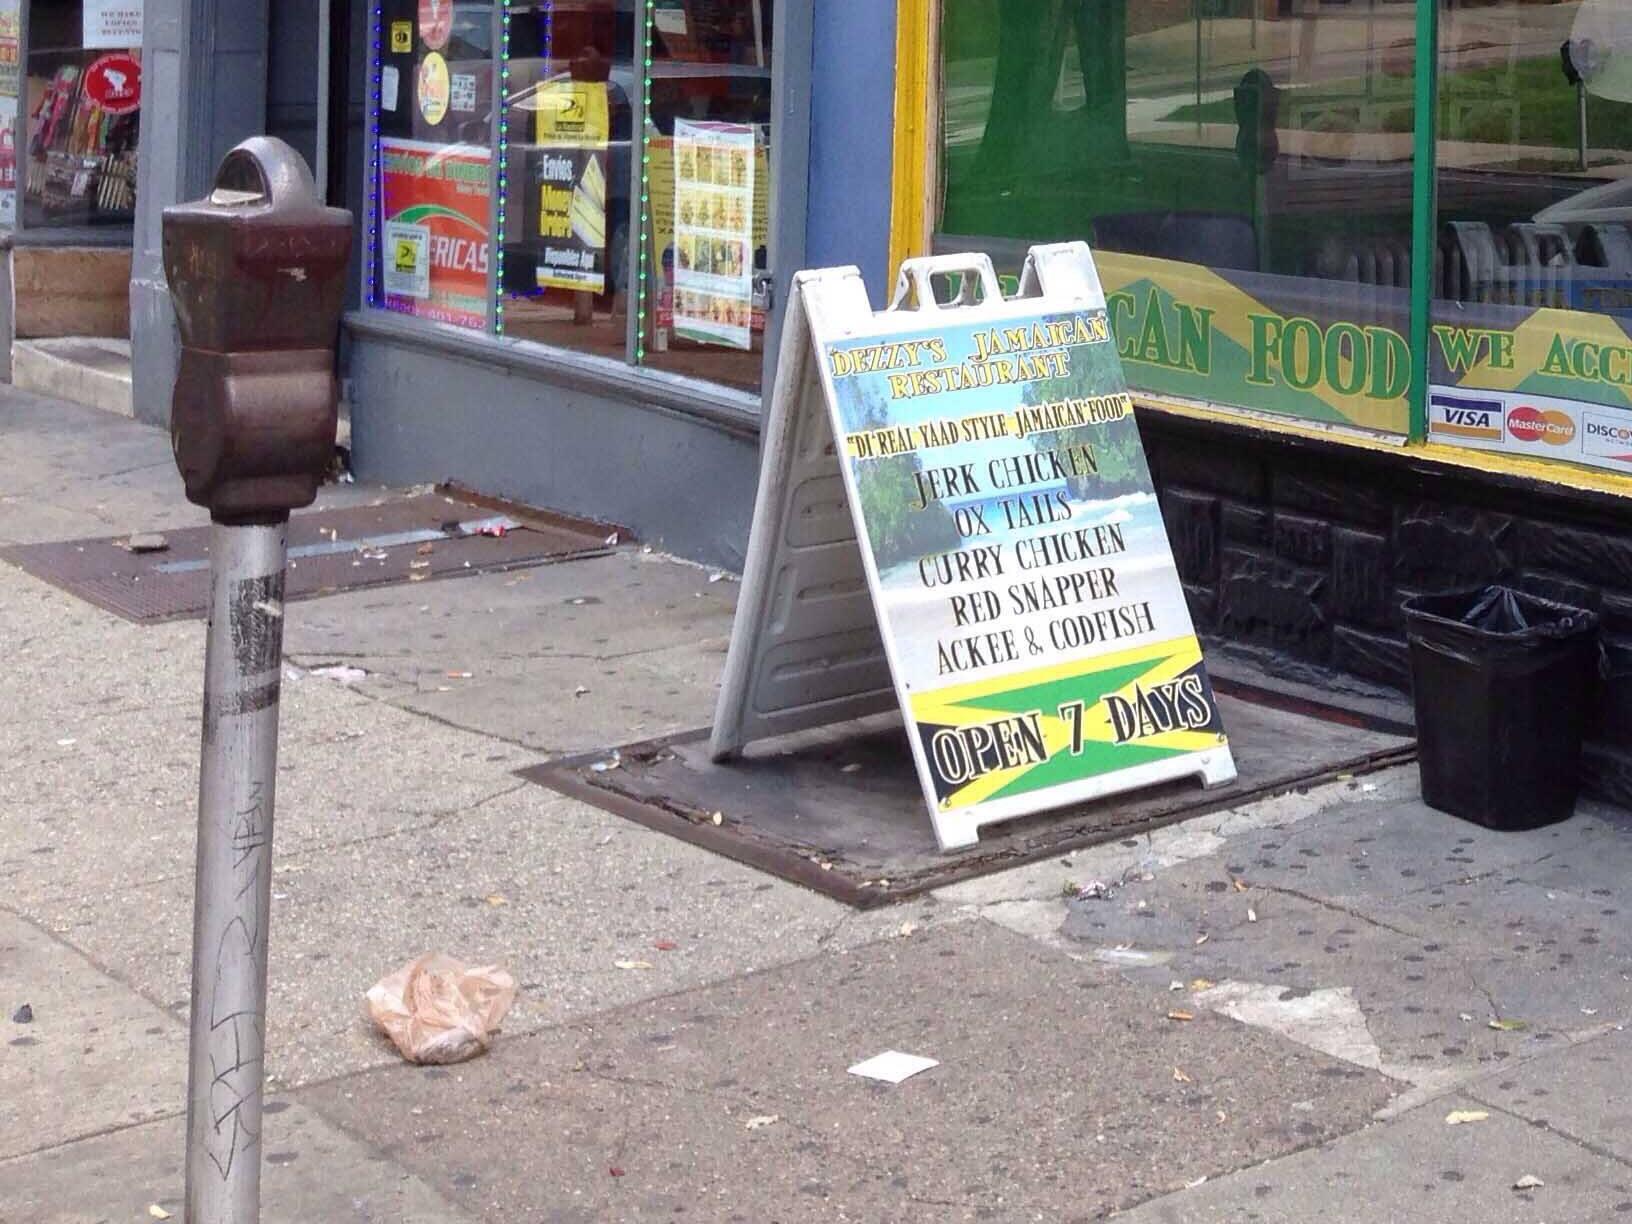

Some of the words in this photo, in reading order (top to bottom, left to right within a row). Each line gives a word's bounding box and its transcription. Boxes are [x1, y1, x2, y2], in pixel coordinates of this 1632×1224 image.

[831, 337, 947, 377] DEZZY'S
[968, 313, 1110, 364] JAMAICAN
[1245, 312, 1412, 402] FOOD
[1431, 324, 1516, 373] WE
[887, 351, 1071, 401] RESTAURANT
[920, 421, 960, 448] YAAD
[963, 413, 1006, 443] STYLE
[1442, 407, 1491, 428] VISA
[1507, 417, 1575, 438] MasterCard
[911, 463, 981, 510] JERK
[988, 444, 1099, 490] CHICKEN
[953, 505, 992, 538] OX
[999, 490, 1073, 530] TAILS
[918, 544, 1005, 589] CURRY
[1014, 522, 1127, 570] CHICKEN
[950, 590, 1002, 627] RED
[1007, 567, 1120, 616] SNAPPER
[937, 629, 1020, 676] ACKEE
[1023, 626, 1044, 656] &
[1048, 601, 1156, 651] CODFISH
[932, 712, 1049, 785] OPEN
[1058, 698, 1087, 756] 7
[1104, 673, 1212, 745] DAYS
